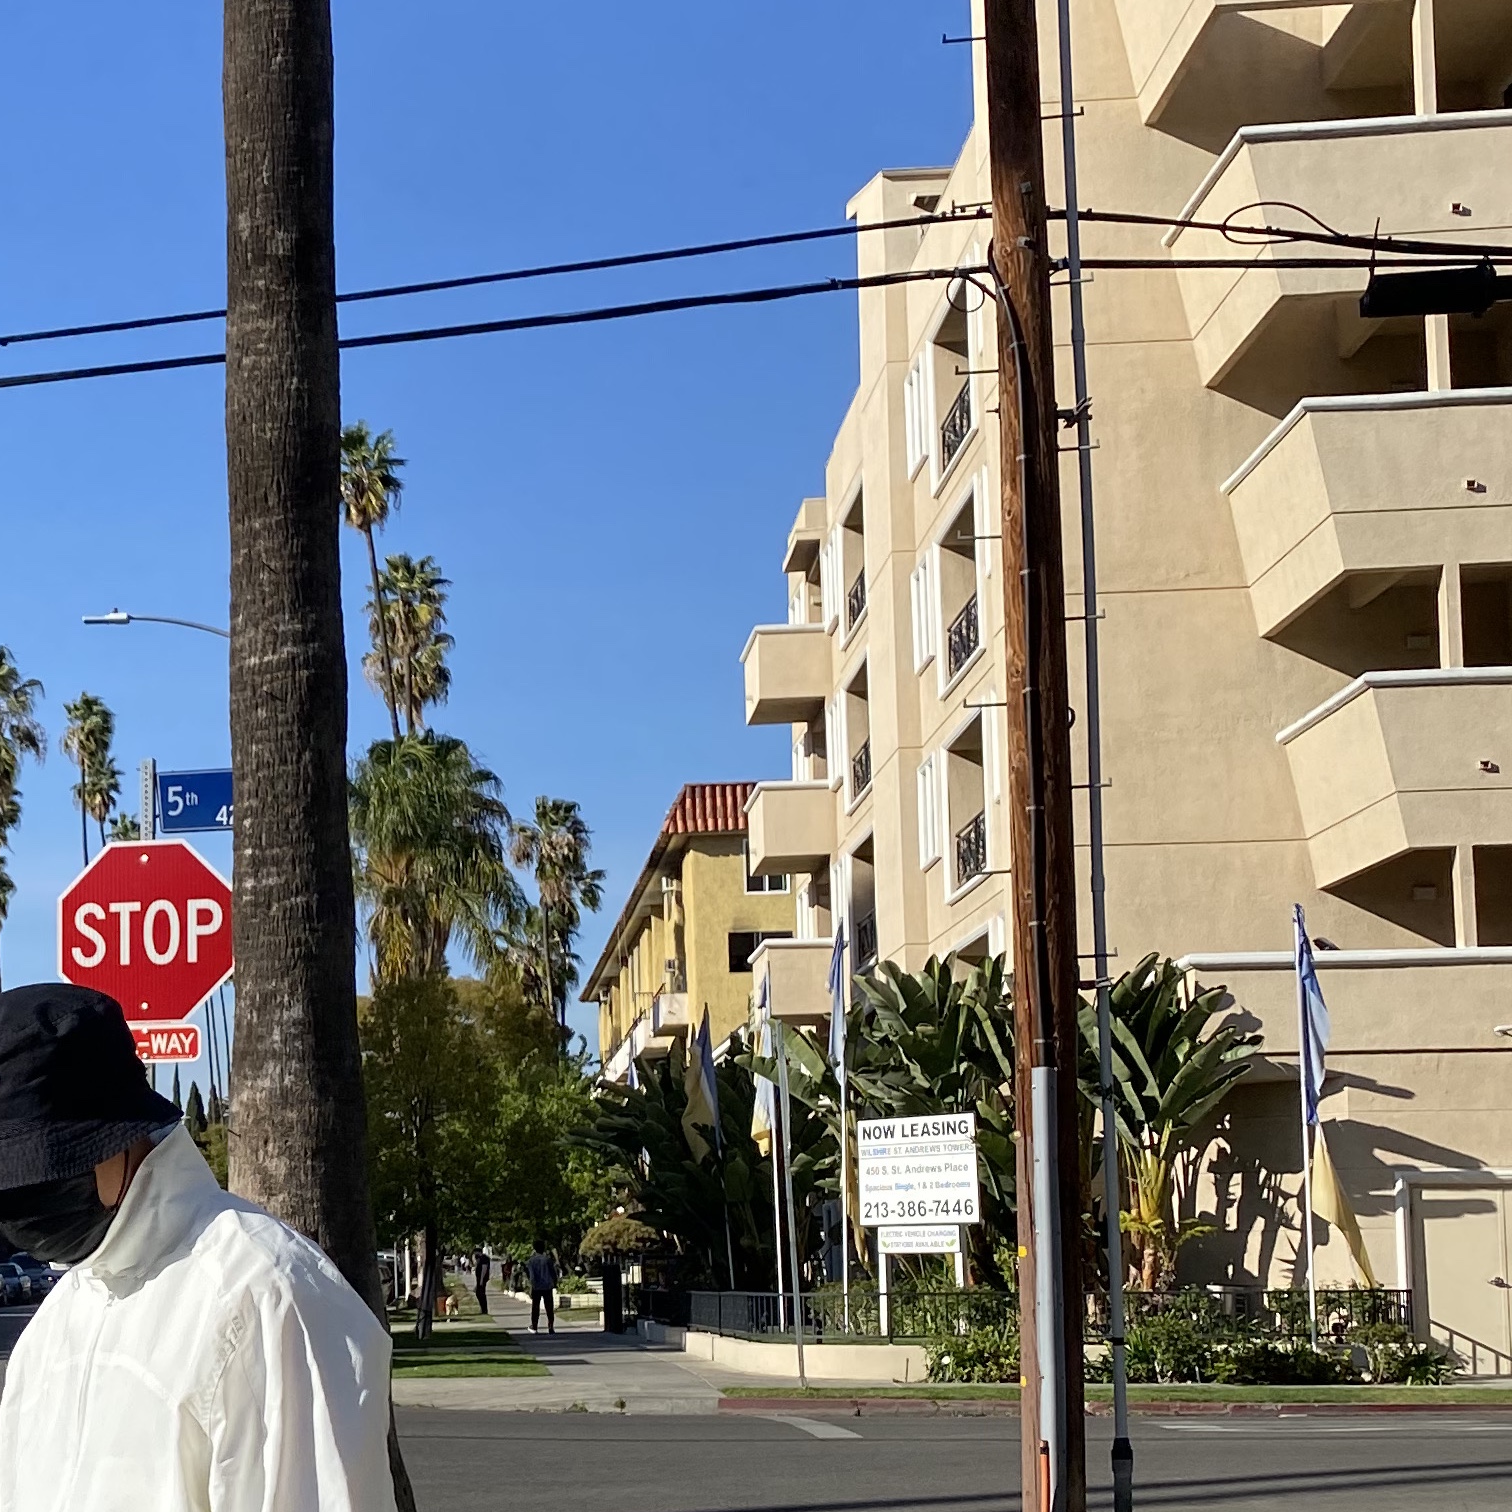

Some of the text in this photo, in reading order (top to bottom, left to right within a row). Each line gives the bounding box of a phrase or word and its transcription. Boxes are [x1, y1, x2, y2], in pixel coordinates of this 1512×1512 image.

[168, 785, 198, 816] 5th
[71, 898, 223, 968] STOP
[136, 1032, 195, 1055] -WAY
[862, 1120, 969, 1140] NOW LEASING
[904, 1144, 941, 1154] ANDREWS
[865, 1166, 880, 1175] 450
[904, 1164, 942, 1174] Andrews
[944, 1162, 969, 1173] Place
[864, 1198, 974, 1219] 213-386-7446
